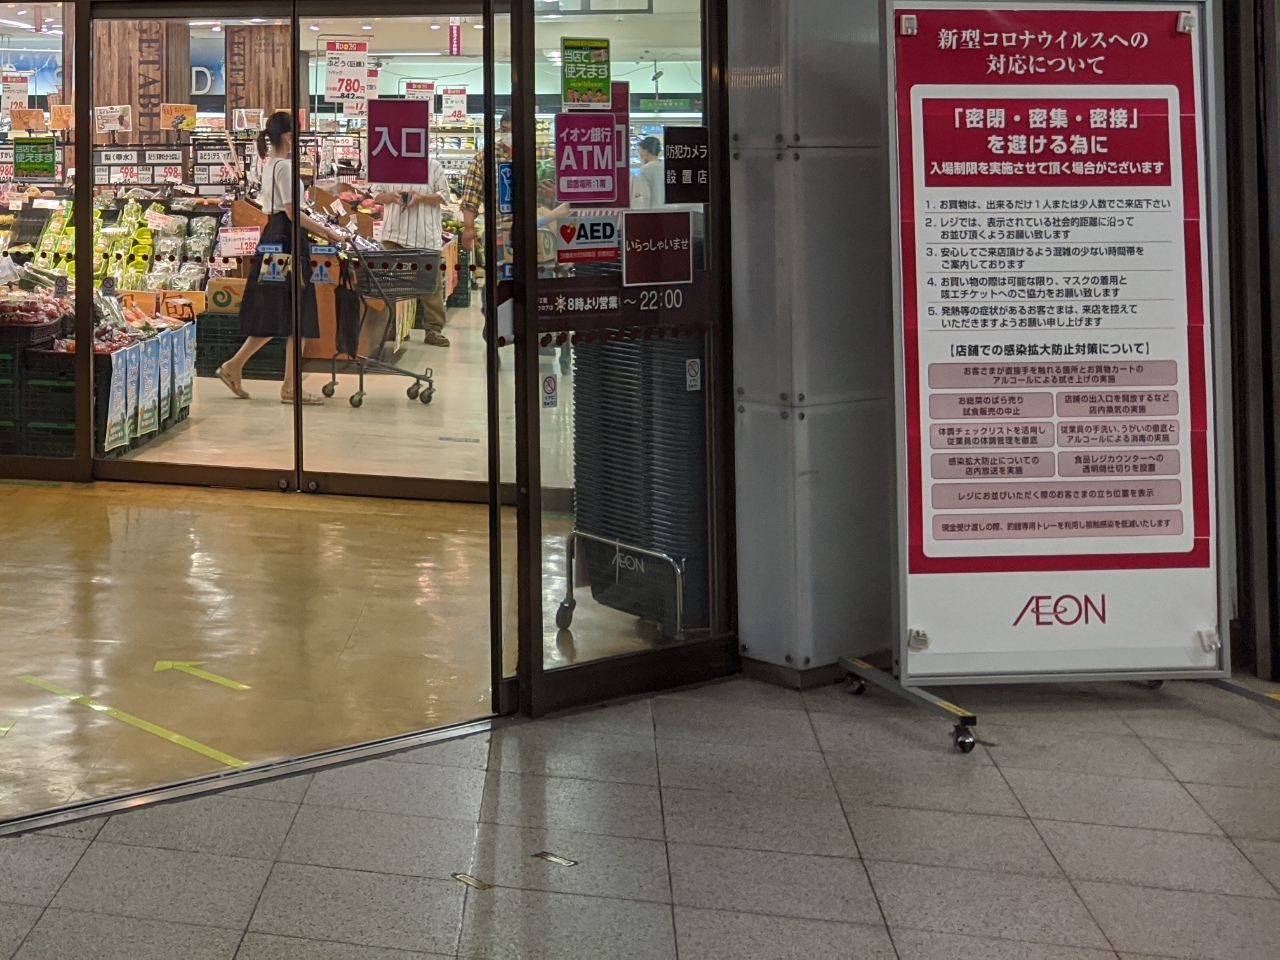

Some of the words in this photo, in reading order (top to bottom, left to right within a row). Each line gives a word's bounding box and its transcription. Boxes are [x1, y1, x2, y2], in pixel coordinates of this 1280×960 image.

[937, 28, 1149, 51] 新型コロナウイルスへの
[564, 49, 589, 62] 当店で
[986, 54, 1105, 76] 対応について
[564, 64, 608, 78] 使えます
[559, 127, 612, 140] イオン銀行
[372, 127, 425, 158] 入口
[987, 135, 1108, 155] を避ける為に
[16, 153, 53, 162] 使えます
[666, 144, 708, 160] 防犯カメラ
[560, 146, 612, 170] ATM
[930, 161, 1164, 175] 入場制限を実施させて頂く場合がございます
[666, 170, 708, 184] 設置店
[939, 199, 1171, 210] お買物は、出来るだけ1人または少人数でご来店下さい
[940, 217, 1134, 228] レジでは、表示されている社会的距離に沿って
[576, 223, 614, 240] AED
[940, 230, 1070, 240] お並び頂くようお願い致します
[626, 238, 688, 252] いらっしゃいませ
[941, 246, 1144, 257] 安心してご来店頂けるよう混雑の少ない時間帯を
[941, 259, 1025, 270] ご案内しております
[941, 276, 1127, 287] お買い物の際は可能な限り、マスクの着用と
[941, 288, 1119, 299] 咳エチケットへのご協力をお願い致します
[567, 296, 618, 310] 8時より営業
[941, 304, 1138, 316] 発熱等の症状があるお客さまは、来店を控えて
[941, 317, 1102, 328] いただきますようお願い申し上げます
[963, 408, 1021, 416] 試食販売の中止
[1089, 406, 1146, 414] 店内換気の実施
[938, 427, 1046, 436] 体調チェックリストを活用し
[947, 436, 1038, 445] 従業員の体調管理を徹底
[1067, 435, 1170, 443] アルコールによる消毒の実施
[948, 456, 1039, 466] 感染拡大防止についての
[1075, 455, 1163, 464] 食品レジカウンターへの
[965, 467, 1023, 476] 店内放送を実施
